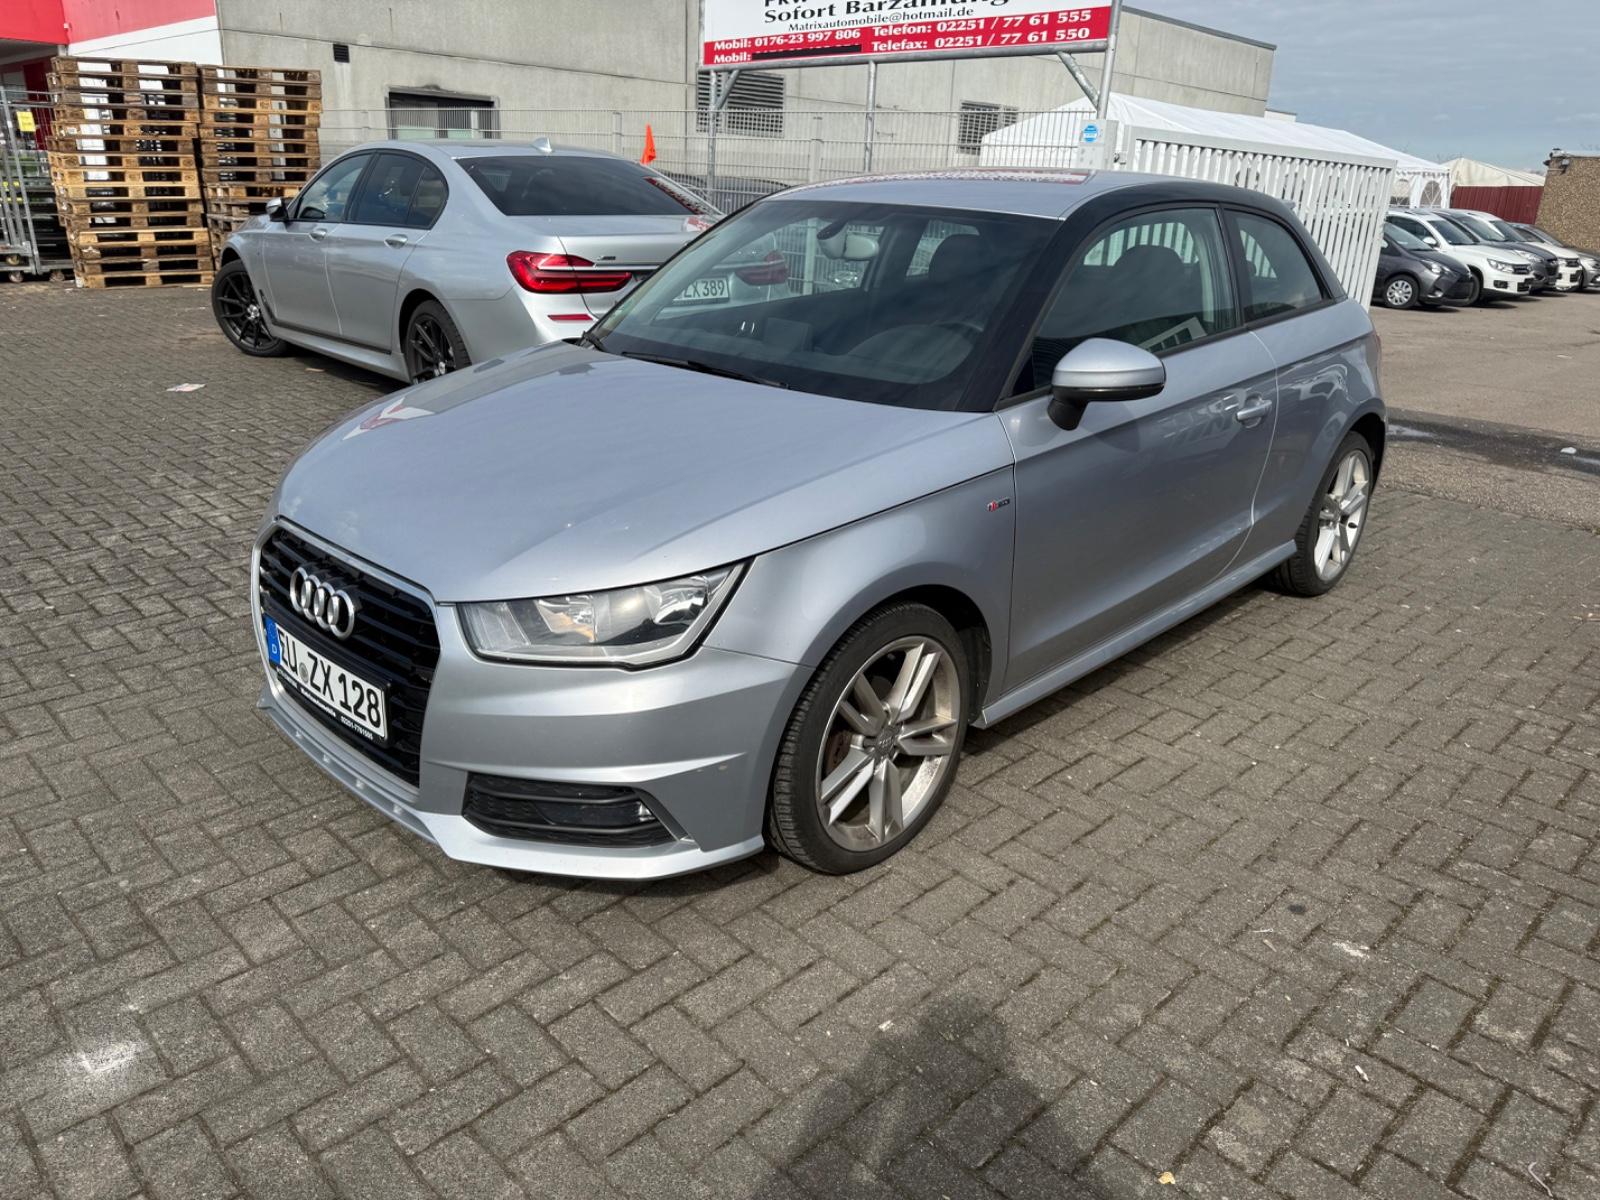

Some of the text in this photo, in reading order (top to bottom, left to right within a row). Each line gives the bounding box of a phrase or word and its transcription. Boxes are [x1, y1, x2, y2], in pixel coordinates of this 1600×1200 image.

[764, 4, 837, 23] Sofort
[788, 7, 974, 32] Matrixautomobile@hotmail.de
[872, 10, 1092, 37] Telefon: 02251 / 77 61 555
[713, 28, 861, 51] Mobil: 0176-23 997 806
[871, 39, 928, 52] Telefax:
[934, 35, 983, 48] 02251
[986, 33, 995, 46] /
[1000, 33, 1022, 45] 77
[1027, 30, 1048, 43] 61
[1055, 27, 1090, 40] 550
[713, 51, 752, 64] Mobil:
[701, 280, 725, 297] 389
[271, 644, 278, 654] D
[307, 651, 335, 702] ZX
[338, 672, 381, 729] 128
